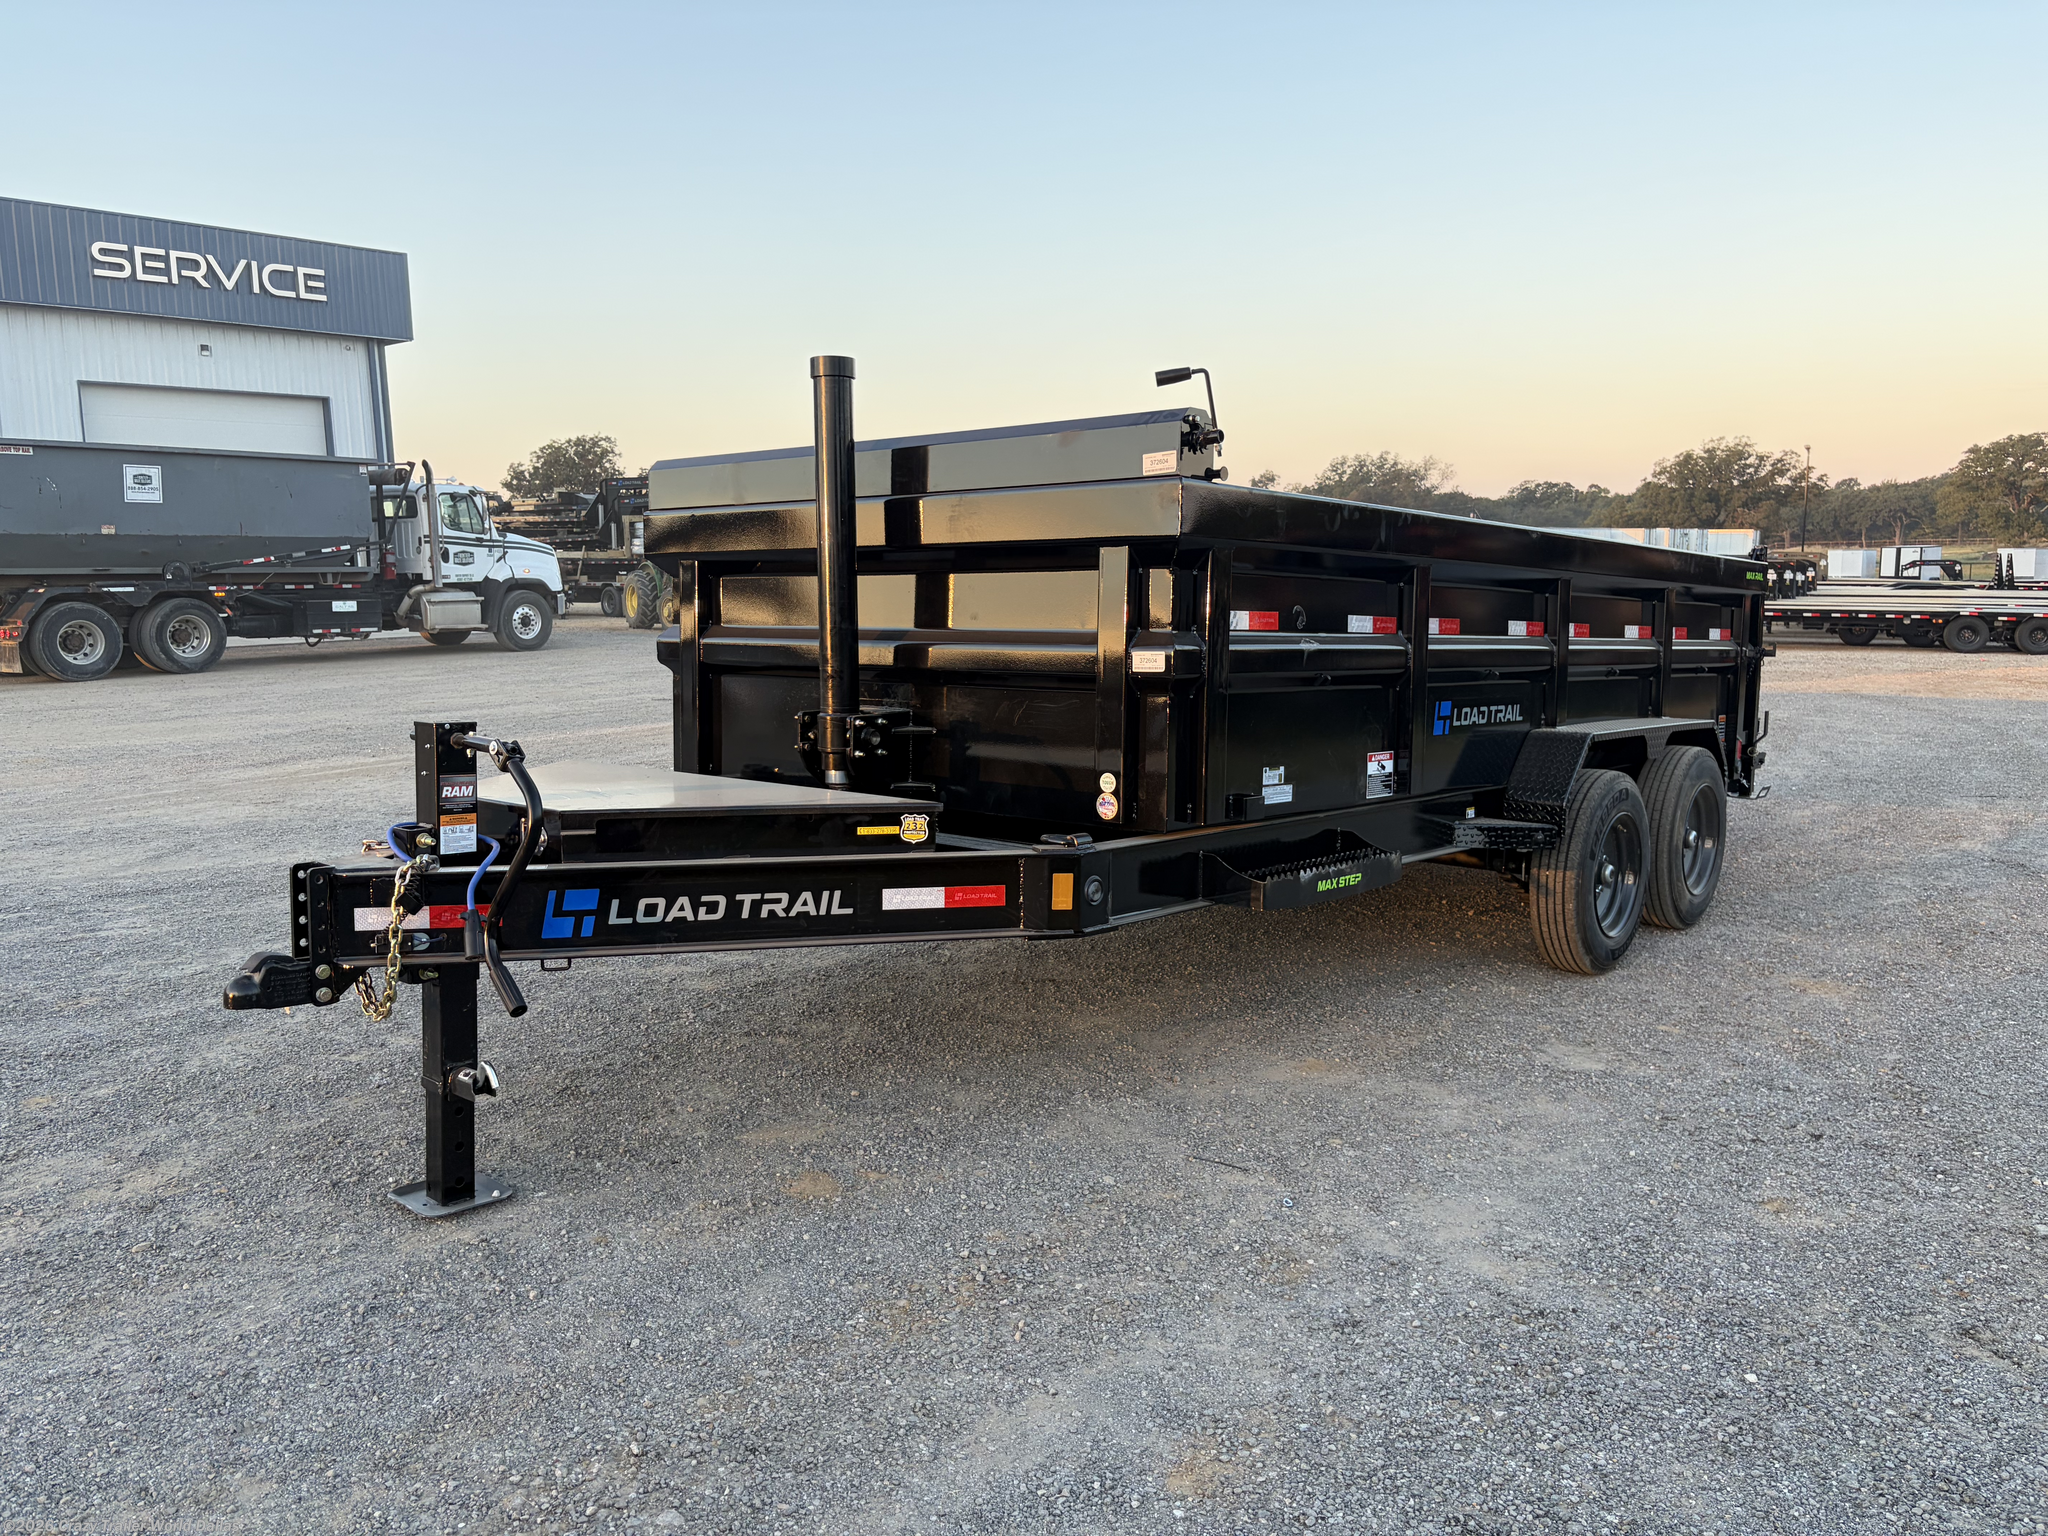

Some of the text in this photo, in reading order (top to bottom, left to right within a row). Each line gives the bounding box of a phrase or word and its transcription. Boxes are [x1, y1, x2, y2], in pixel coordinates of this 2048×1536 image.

[91, 241, 328, 301] SERVICE
[1150, 458, 1169, 466] 372604
[1453, 704, 1523, 726] LOAD TRAIL
[441, 785, 474, 798] RAM
[1317, 873, 1362, 892] MAX STEP
[608, 890, 854, 925] LOAD TRAIL
